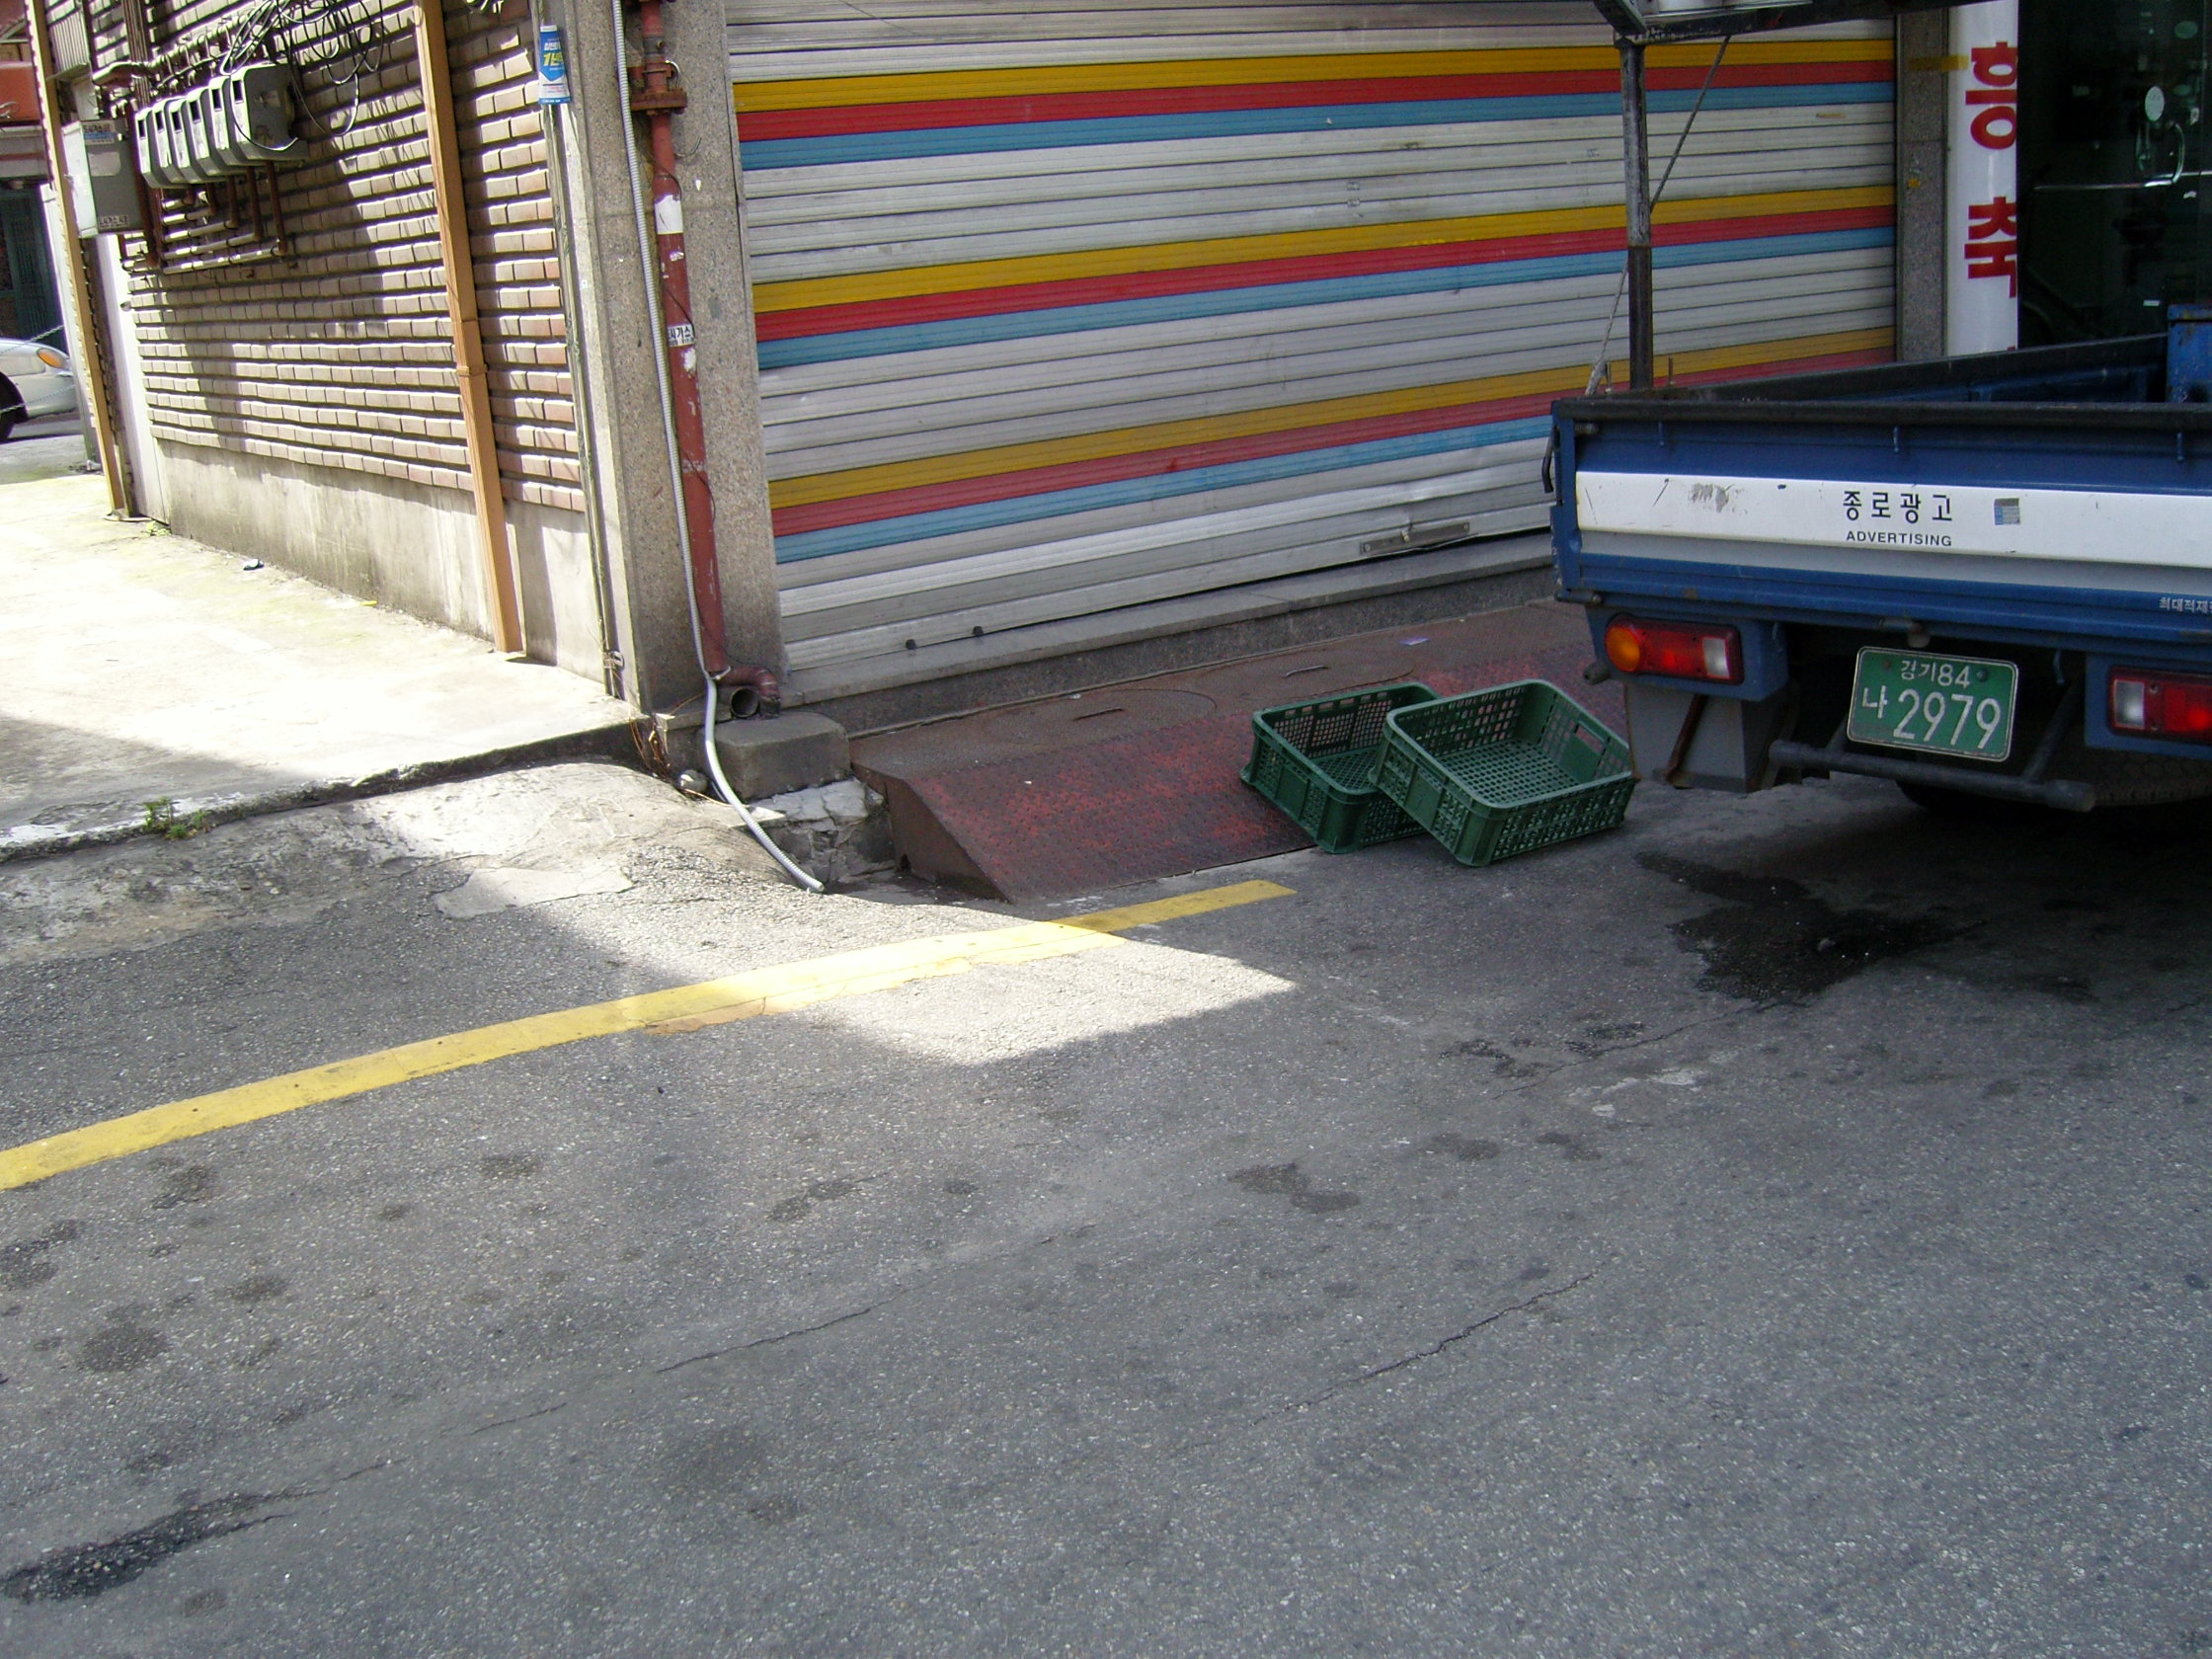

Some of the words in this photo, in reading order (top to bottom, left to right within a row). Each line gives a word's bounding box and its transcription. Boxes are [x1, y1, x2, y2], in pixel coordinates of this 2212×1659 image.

[1843, 490, 1953, 524] 종로광고
[1846, 530, 1952, 546] ADVERTISING
[1901, 660, 1971, 689] 경기84
